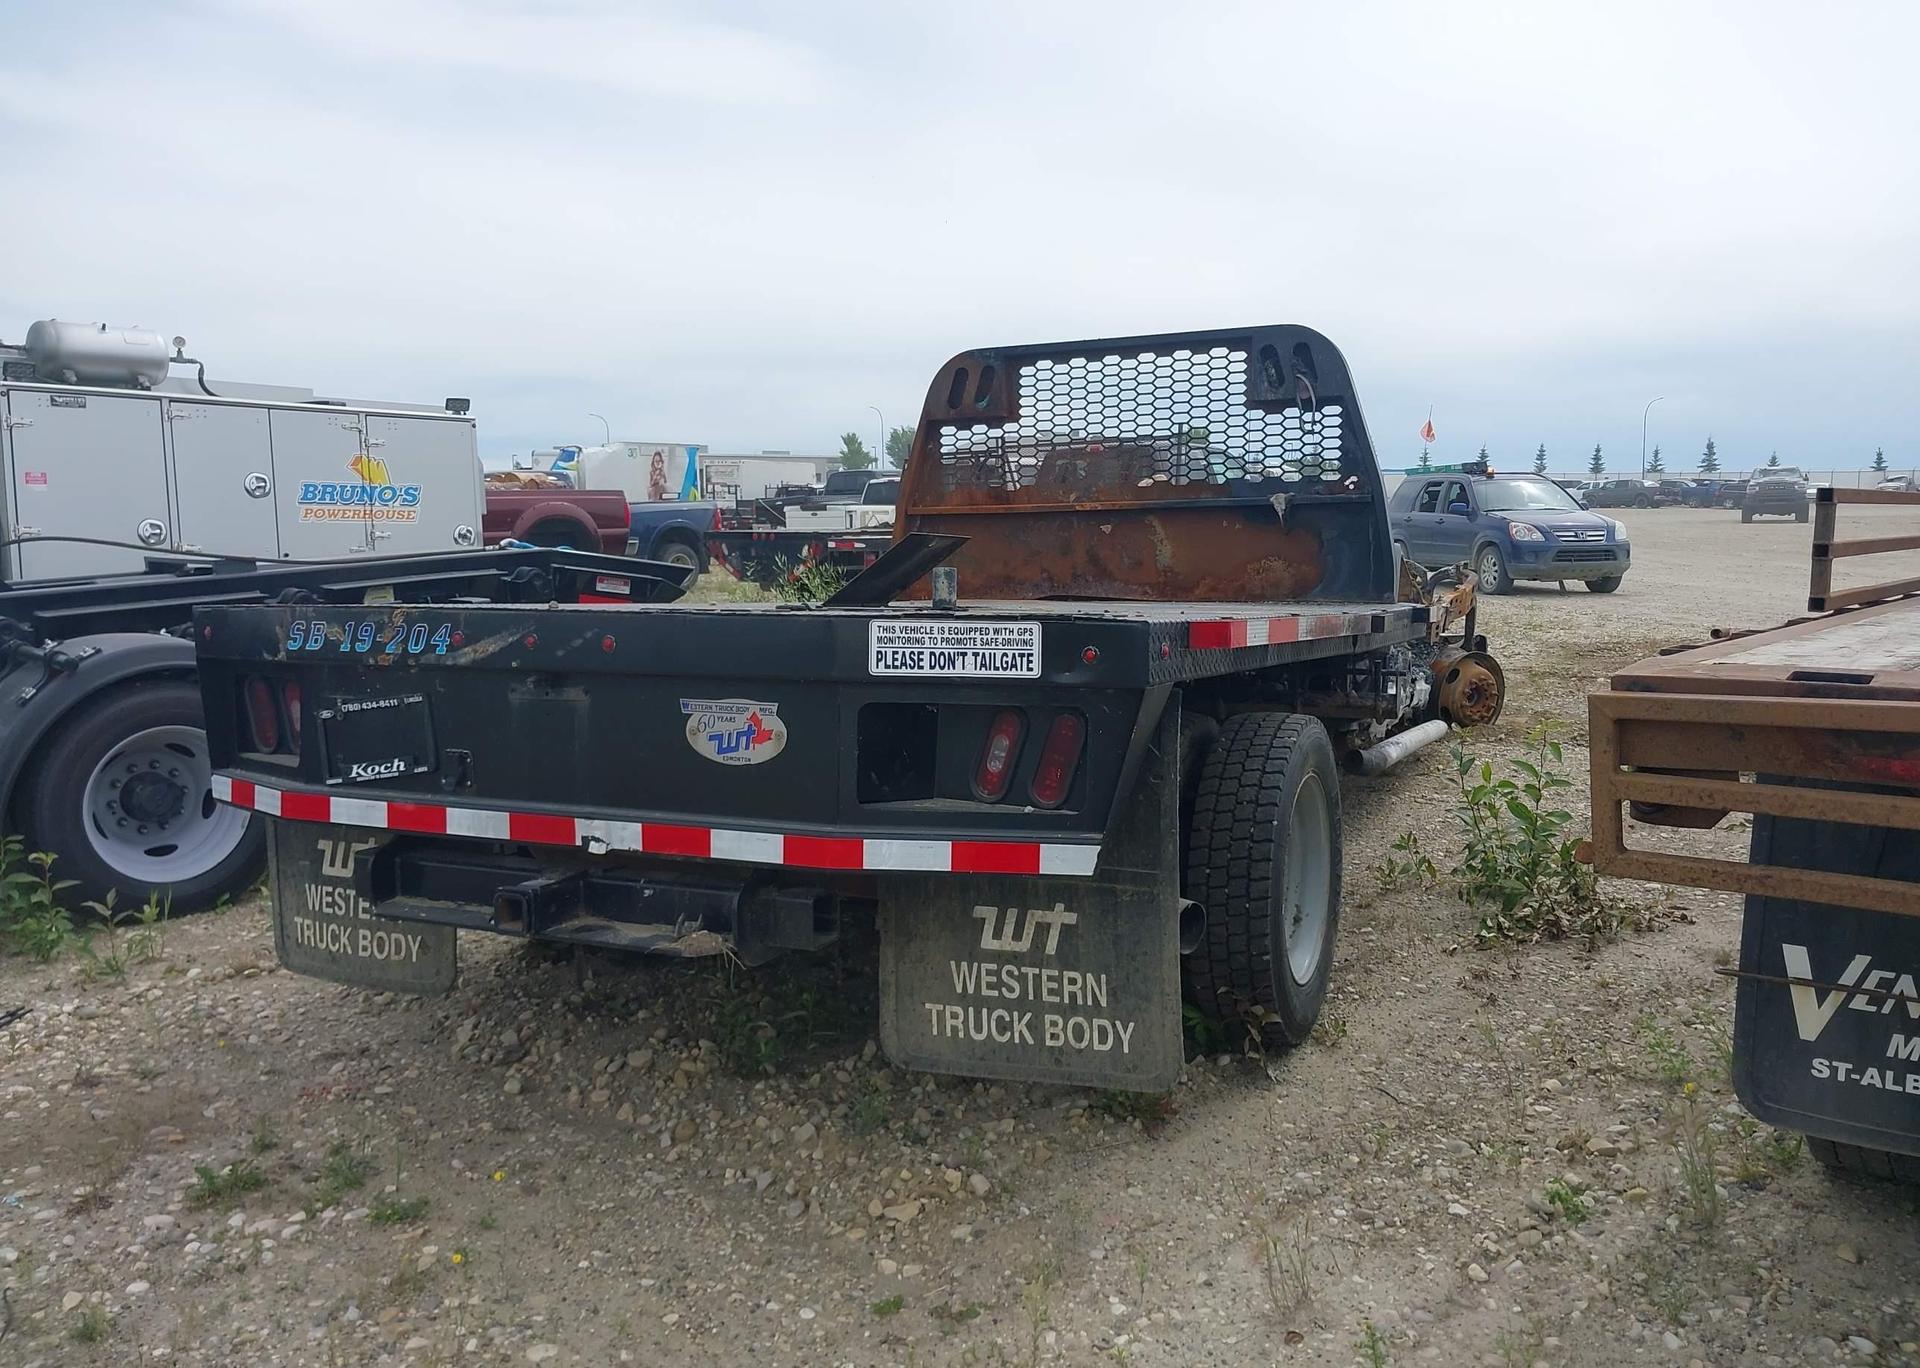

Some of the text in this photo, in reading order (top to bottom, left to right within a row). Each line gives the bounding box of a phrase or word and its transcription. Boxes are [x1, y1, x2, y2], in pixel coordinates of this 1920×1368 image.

[298, 483, 421, 506] BRUNO'S
[302, 508, 417, 520] POWERHOUSE
[877, 625, 1034, 637] THIS VEHICLE IS EQUIPPED WITH GPS
[876, 635, 1034, 648] MONITORING TO PROMOTE SAFE-DRIVING
[876, 650, 1034, 672] PLEASE DON'T TAILGATE
[361, 699, 398, 710] 434-8411
[681, 700, 713, 711] WESTERN
[715, 704, 735, 712] TRUCK
[735, 705, 751, 713] BODY
[697, 714, 716, 733] 60
[349, 758, 406, 778] Koch
[305, 883, 376, 920] WESTE
[294, 916, 422, 963] TRUCK BODY
[950, 960, 1107, 1007] WESTERN
[925, 1003, 1135, 1054] TRUCK BODY
